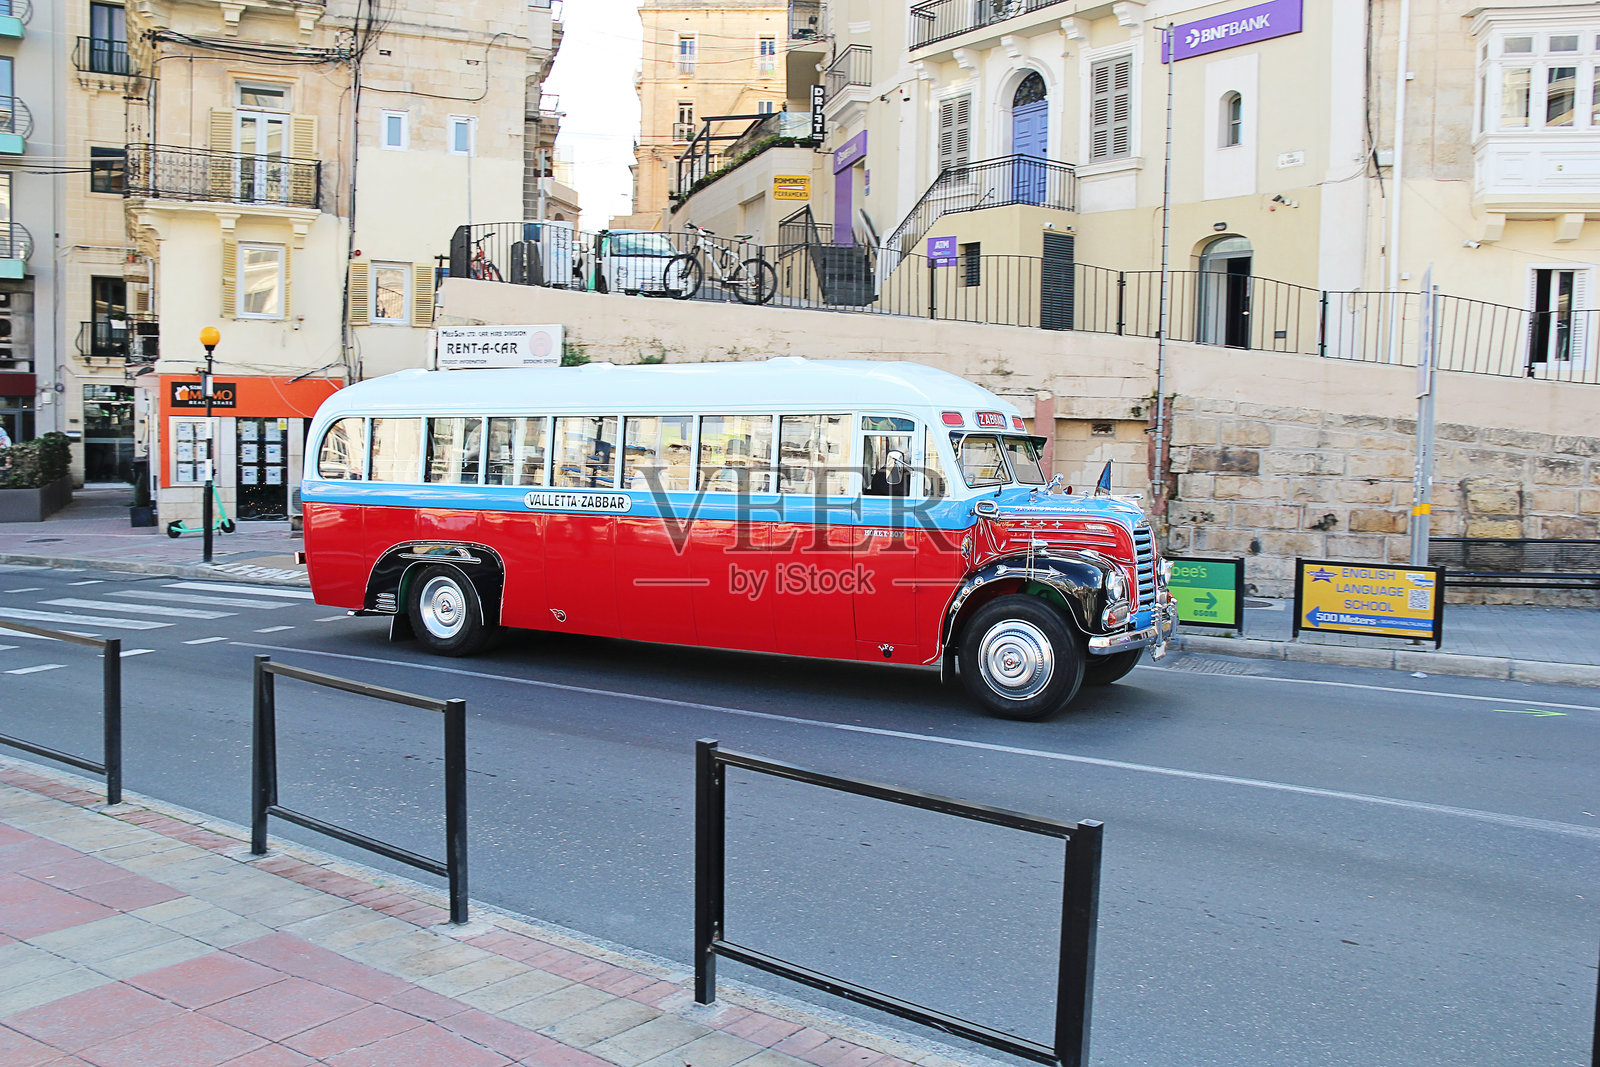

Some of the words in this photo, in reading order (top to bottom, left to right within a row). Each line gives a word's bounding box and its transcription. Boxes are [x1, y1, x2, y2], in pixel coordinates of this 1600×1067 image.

[935, 240, 950, 249] ATM
[447, 343, 518, 355] RENT-A-CAR
[190, 390, 233, 400] MMO
[1341, 567, 1396, 580] ENGLISH
[1336, 583, 1404, 597] LANGUAGE
[1344, 599, 1395, 612] SCHOOL
[1316, 612, 1338, 622] 500
[1339, 615, 1377, 625] Meters
